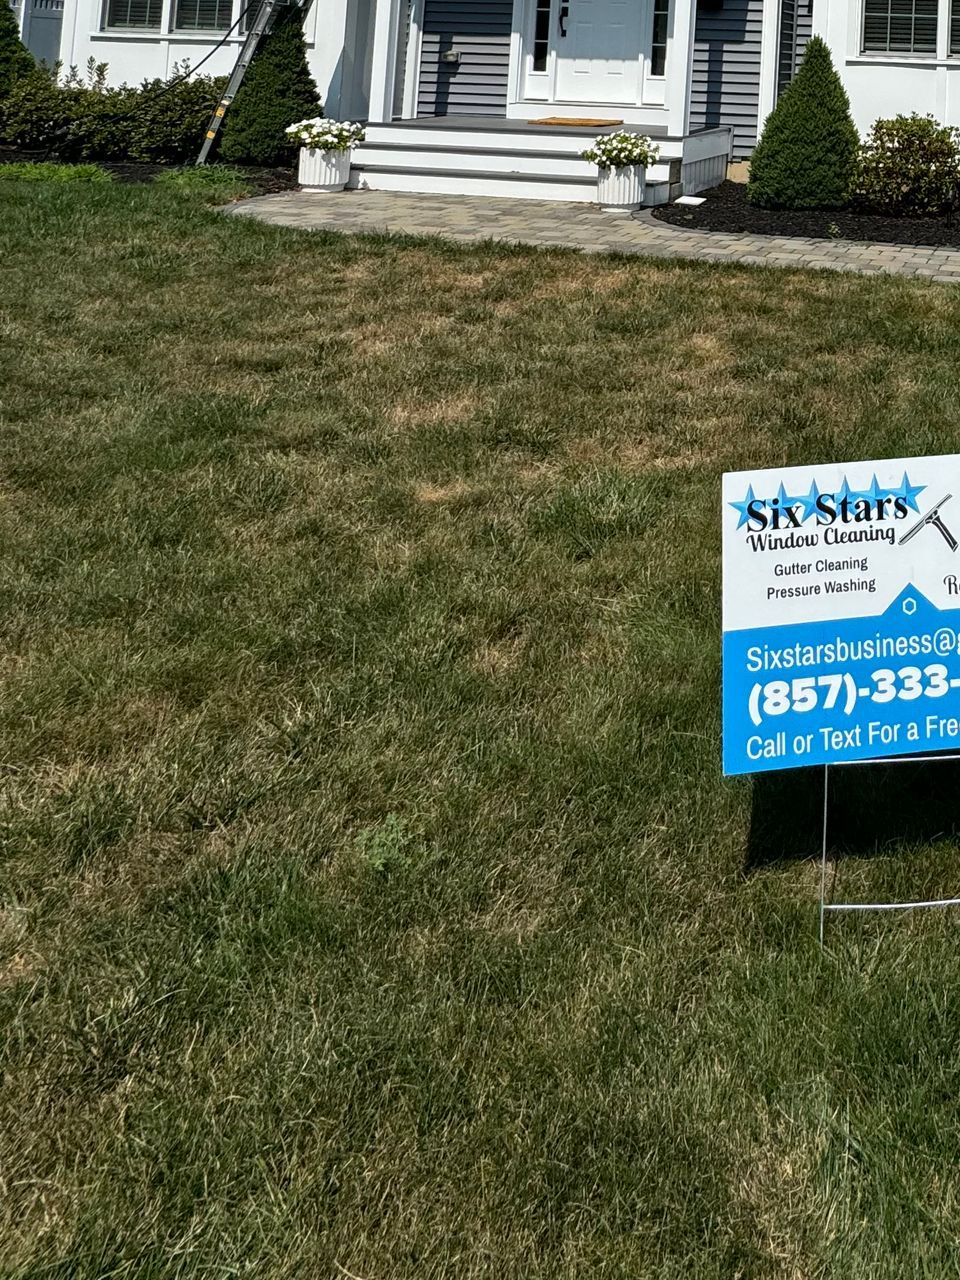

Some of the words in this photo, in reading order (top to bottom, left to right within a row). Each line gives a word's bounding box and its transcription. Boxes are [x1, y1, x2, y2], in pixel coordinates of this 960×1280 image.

[747, 499, 802, 533] Six
[815, 493, 908, 526] Stars
[746, 531, 819, 552] Window
[823, 525, 895, 545] Cleaning
[774, 562, 812, 576] Gutter
[815, 557, 868, 572] Cleaning
[767, 584, 821, 600] Pressure
[824, 578, 876, 594] Washing
[746, 732, 786, 760] Call
[793, 734, 814, 754] or
[819, 724, 861, 751] Text
[868, 721, 901, 745] For
[907, 722, 919, 741] a
